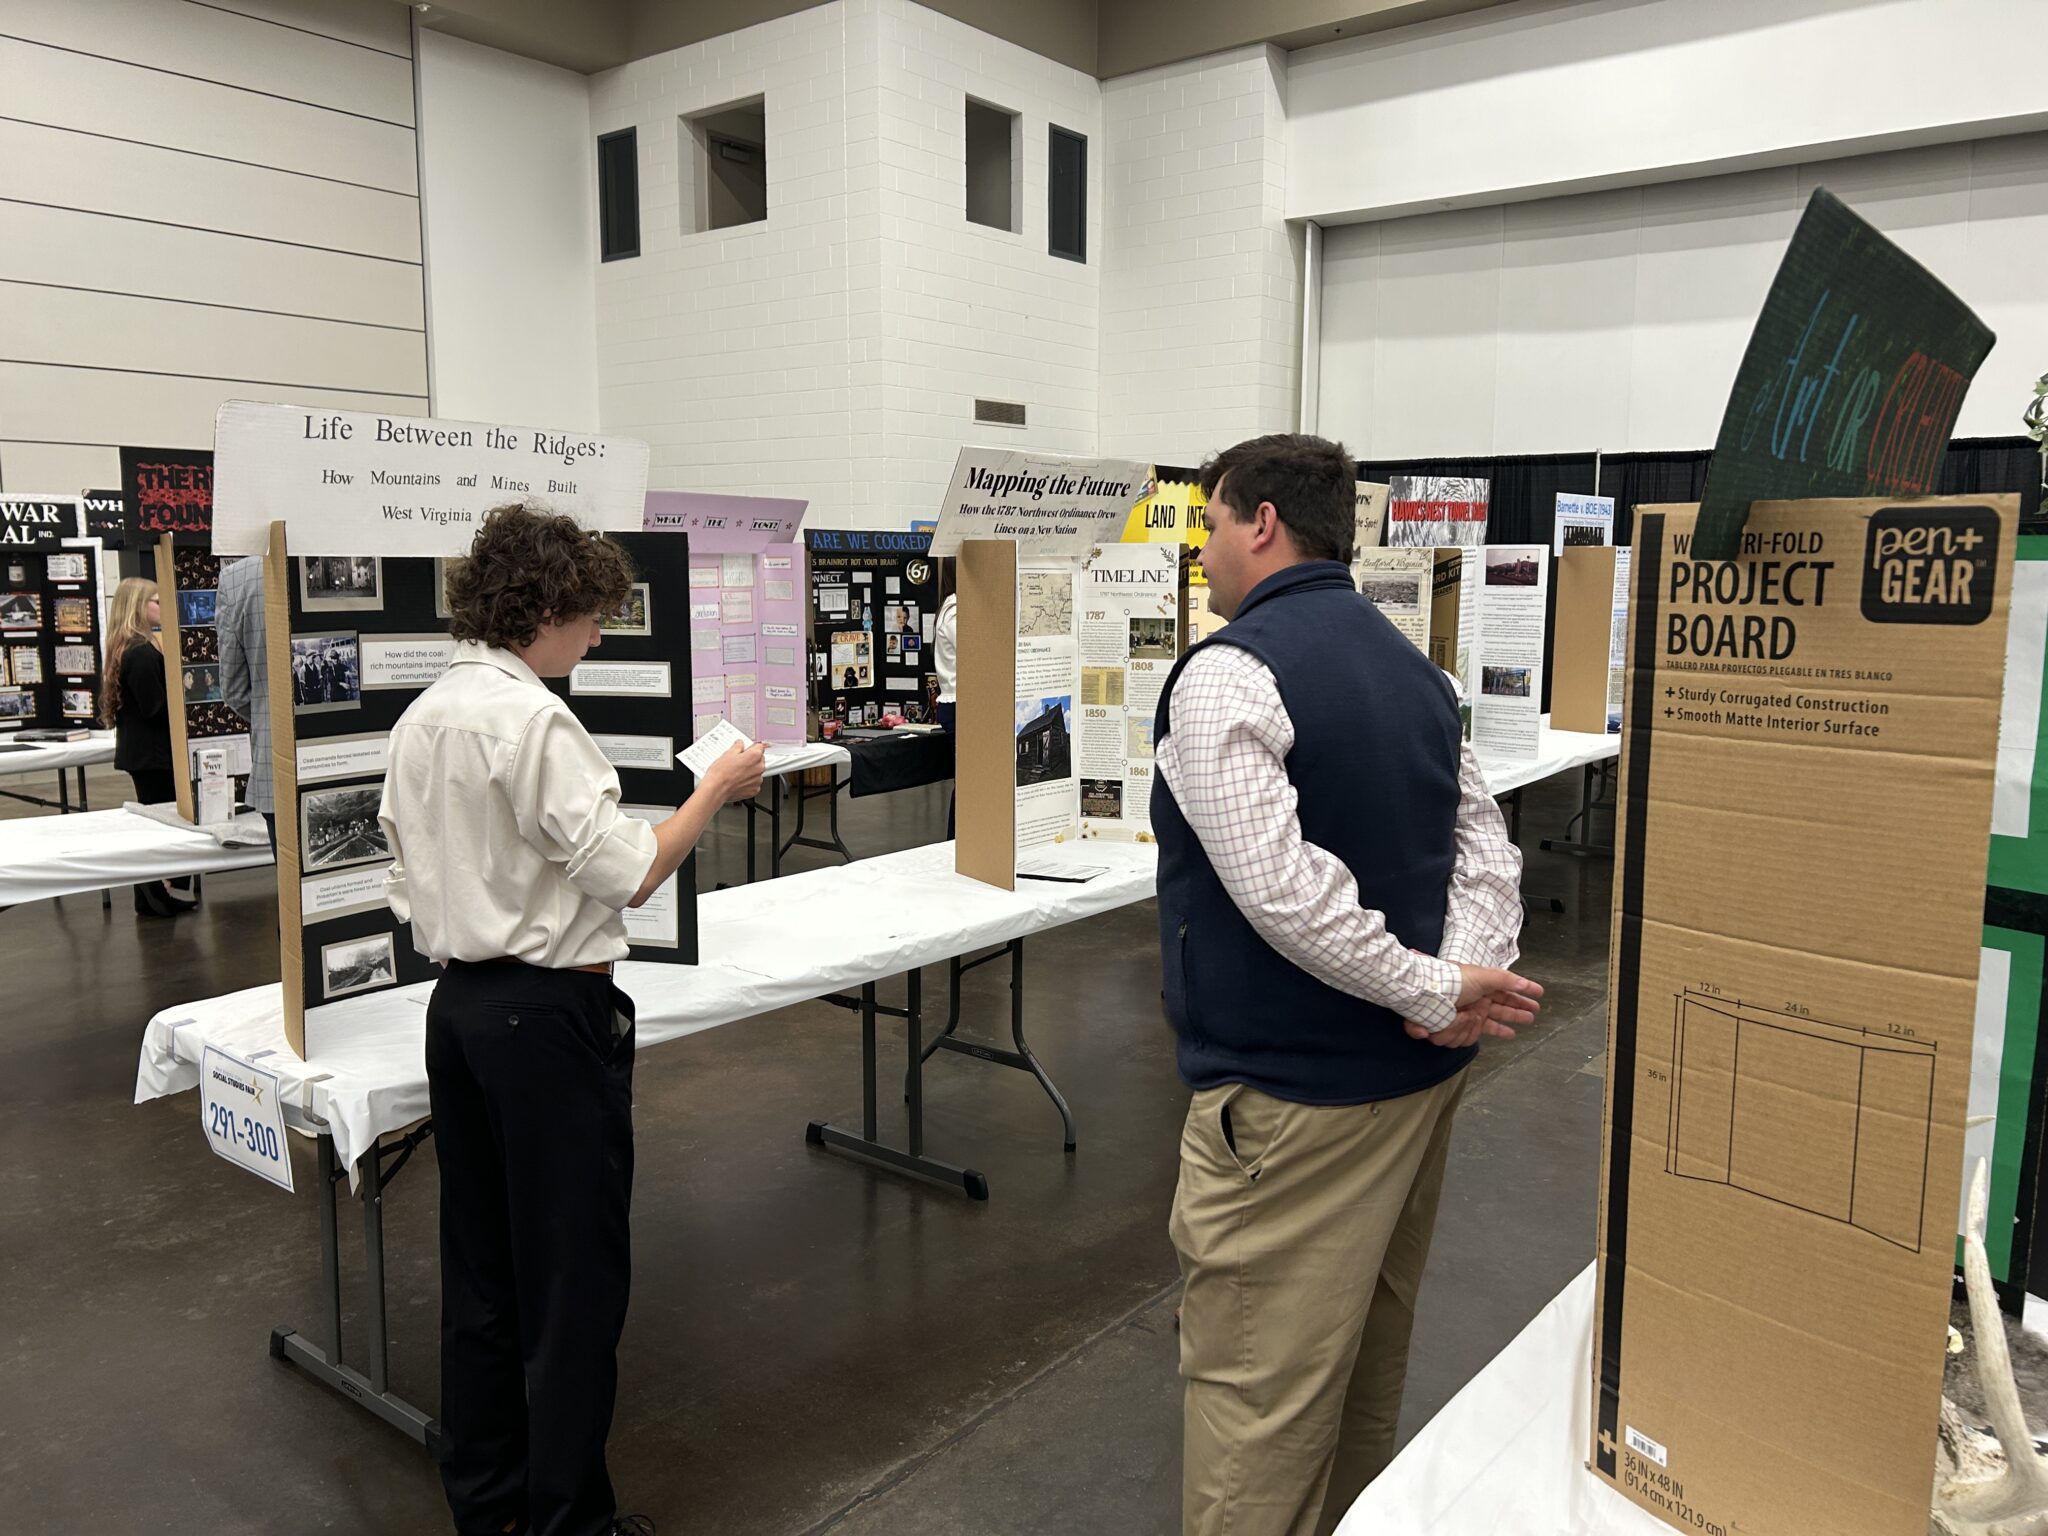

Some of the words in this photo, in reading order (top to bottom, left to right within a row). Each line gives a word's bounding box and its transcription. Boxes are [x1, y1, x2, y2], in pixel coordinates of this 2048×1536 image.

[303, 415, 353, 440] Life
[375, 419, 473, 447] Between
[485, 426, 518, 450] the
[532, 431, 606, 466] Ridges:
[322, 470, 354, 486] How
[370, 471, 441, 487] Mountains
[456, 473, 477, 488] and
[490, 475, 530, 493] Mines
[547, 479, 577, 495] Built
[963, 467, 1049, 500] Mapping
[1049, 474, 1076, 496] the
[1076, 476, 1131, 498] Future
[0, 503, 61, 523] WAR
[382, 505, 413, 521] West
[420, 507, 472, 526] Virginia
[959, 504, 980, 515] How
[982, 505, 996, 516] the
[997, 505, 1016, 517] 1787
[1017, 507, 1058, 518] Northwest
[1059, 507, 1097, 519] Ordinance
[1097, 508, 1116, 519] Drew
[1145, 504, 1176, 529] LAND
[1426, 501, 1446, 522] NEST
[1586, 503, 1597, 515] BOE
[656, 516, 682, 524] WHAT
[707, 519, 723, 527] THE
[753, 521, 778, 529] FONT?
[994, 523, 1016, 535] Lines
[1018, 526, 1028, 534] on
[1030, 527, 1035, 535] a
[1036, 525, 1052, 535] New
[1053, 525, 1077, 535] Nation
[813, 532, 840, 549] ARE
[846, 533, 870, 549] WE
[874, 534, 932, 550] COOKED?
[819, 558, 848, 566] BRAINROT
[850, 558, 861, 566] ROT
[864, 558, 878, 566] YOUR
[910, 565, 929, 580] 67
[1091, 569, 1169, 583] TIMELINE
[1448, 566, 1460, 578] KIT
[1670, 561, 1834, 606] PROJECT
[1881, 559, 1974, 605] GEAR
[1085, 611, 1106, 620] 1787
[1667, 613, 1796, 660] BOARD
[385, 651, 402, 659] How
[403, 650, 414, 658] did
[416, 650, 427, 658] the
[428, 650, 447, 658] coal-
[370, 662, 384, 670] rich
[385, 662, 423, 670] mountains
[424, 661, 448, 670] impact
[1130, 662, 1153, 671] 1808
[1666, 660, 1698, 671] TABLERO
[1700, 662, 1719, 672] PARA
[1722, 663, 1767, 675] PROYECTOS
[1769, 666, 1812, 677] PLEGABLE
[1815, 669, 1827, 678] EN
[1829, 669, 1851, 679] TRES
[1855, 671, 1893, 681] BLANCO
[391, 672, 441, 680] communities?
[1678, 687, 1716, 705] Sturdy
[1720, 690, 1792, 708] Corrugated
[1796, 696, 1889, 714] Construction
[1085, 709, 1107, 718] 1850
[1677, 707, 1721, 724] Smooth
[1725, 711, 1762, 727] Matte
[1767, 715, 1820, 732] Interior
[1824, 719, 1880, 737] Surface
[1129, 767, 1149, 776] 1861
[1699, 982, 1710, 992] 12
[1711, 984, 1720, 995] in
[1785, 1002, 1797, 1012] 24
[1799, 1004, 1809, 1015] in
[1887, 1023, 1899, 1034] 12
[1903, 1026, 1915, 1037] in
[213, 1070, 227, 1083] SOCIAL
[228, 1077, 245, 1091] STUDIES
[245, 1083, 256, 1096] FAIR
[1647, 1069, 1658, 1080] 36
[1659, 1071, 1667, 1082] in
[210, 1102, 279, 1161] 291-300
[1624, 1451, 1636, 1471] 36
[1638, 1459, 1648, 1479] IN
[1650, 1470, 1656, 1484] x
[1657, 1473, 1670, 1492] 48
[1672, 1480, 1683, 1500] IN
[1624, 1469, 1648, 1496] (91.4
[1650, 1489, 1664, 1507] cm
[1666, 1498, 1673, 1512] x
[1675, 1501, 1704, 1528] 121.9
